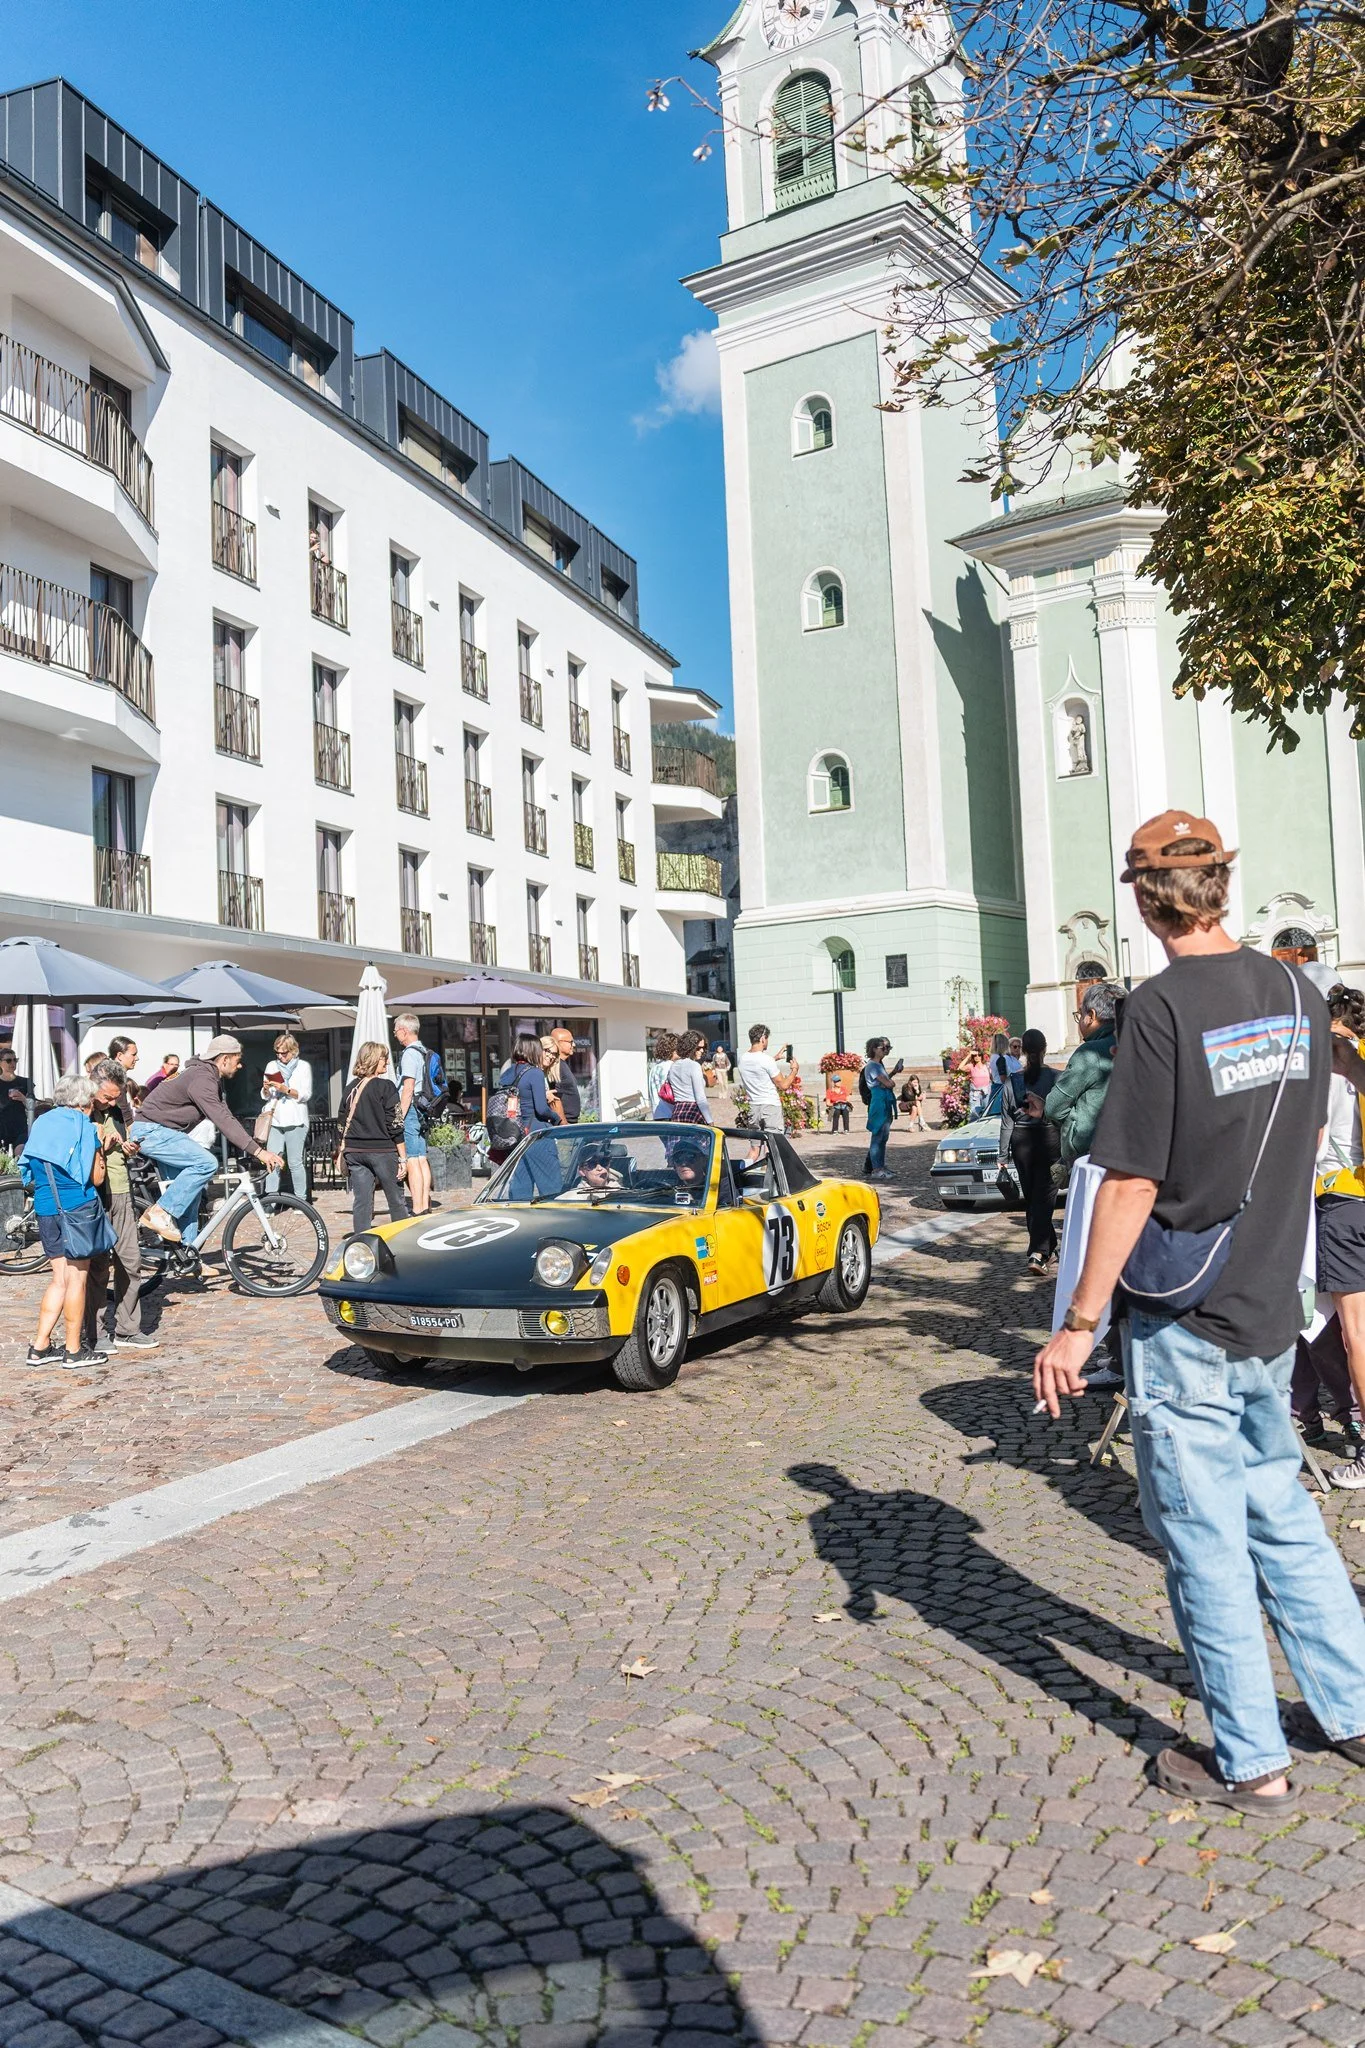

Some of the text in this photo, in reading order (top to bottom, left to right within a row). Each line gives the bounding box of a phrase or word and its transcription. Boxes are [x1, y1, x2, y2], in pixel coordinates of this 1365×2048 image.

[313, 1219, 326, 1251] DT SWISS
[423, 1219, 515, 1247] 73
[816, 1220, 832, 1233] BOSCH
[768, 1215, 794, 1286] 73
